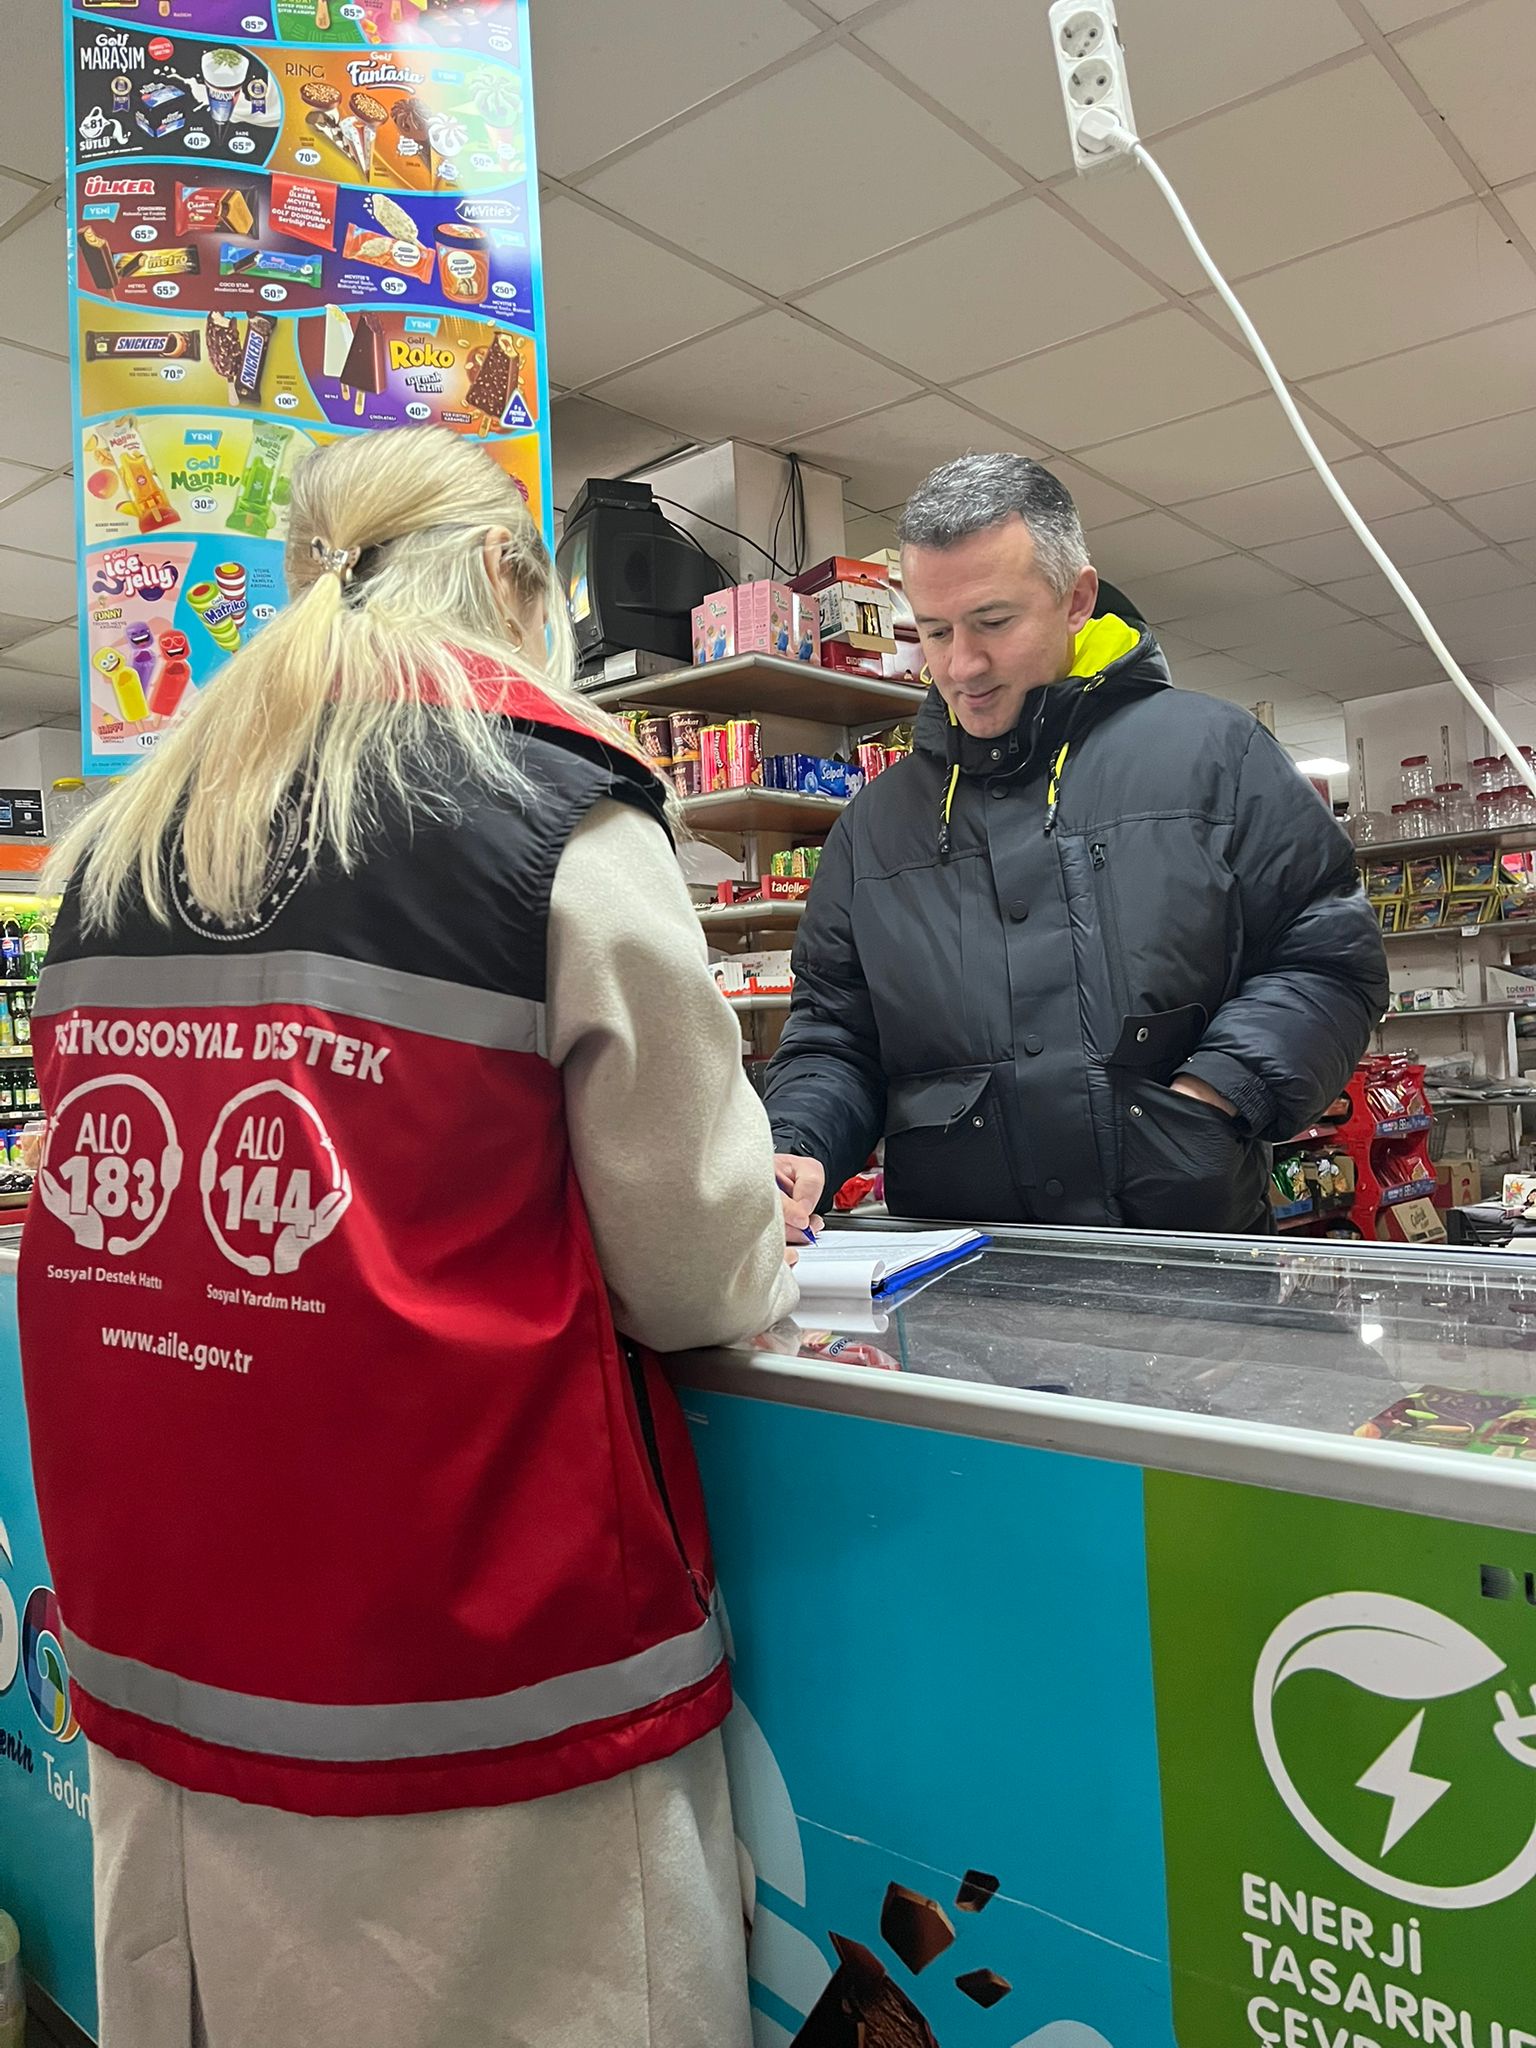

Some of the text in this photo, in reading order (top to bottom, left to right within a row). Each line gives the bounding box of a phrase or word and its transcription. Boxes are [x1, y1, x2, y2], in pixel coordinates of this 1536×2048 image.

[96, 34, 129, 47] Golf
[80, 46, 145, 74] MARAŞIM
[286, 63, 325, 79] RING
[79, 135, 111, 151] SÜTLÜ
[84, 175, 156, 196] ÜLKER
[89, 206, 111, 215] YENİ
[410, 319, 431, 330] YENİ
[117, 337, 167, 350] SNICKERS
[389, 340, 455, 370] Roko
[241, 332, 264, 388] SNICKERS
[190, 432, 214, 442] YENİ
[186, 455, 221, 471] Golf
[171, 471, 240, 493] Manav
[103, 553, 140, 578] ice
[124, 564, 174, 597] jelly
[94, 608, 122, 621] FUNNY
[204, 600, 249, 624] Matriko
[821, 765, 846, 780] Selpak
[771, 880, 805, 895] tadelle
[1506, 985, 1536, 994] totem
[55, 1010, 392, 1085] SİKOSOSYAL DESTEK
[75, 1113, 132, 1155] ALO
[235, 1116, 285, 1161] ALO
[59, 1156, 155, 1221] 183
[219, 1165, 316, 1238] 144
[47, 1264, 162, 1290] Sosyal Destek Hattı
[206, 1284, 326, 1314] Sosyal Yardım Hattı
[101, 1326, 253, 1374] www.aile.gov.tr
[1242, 1872, 1422, 1975] ENERJİ
